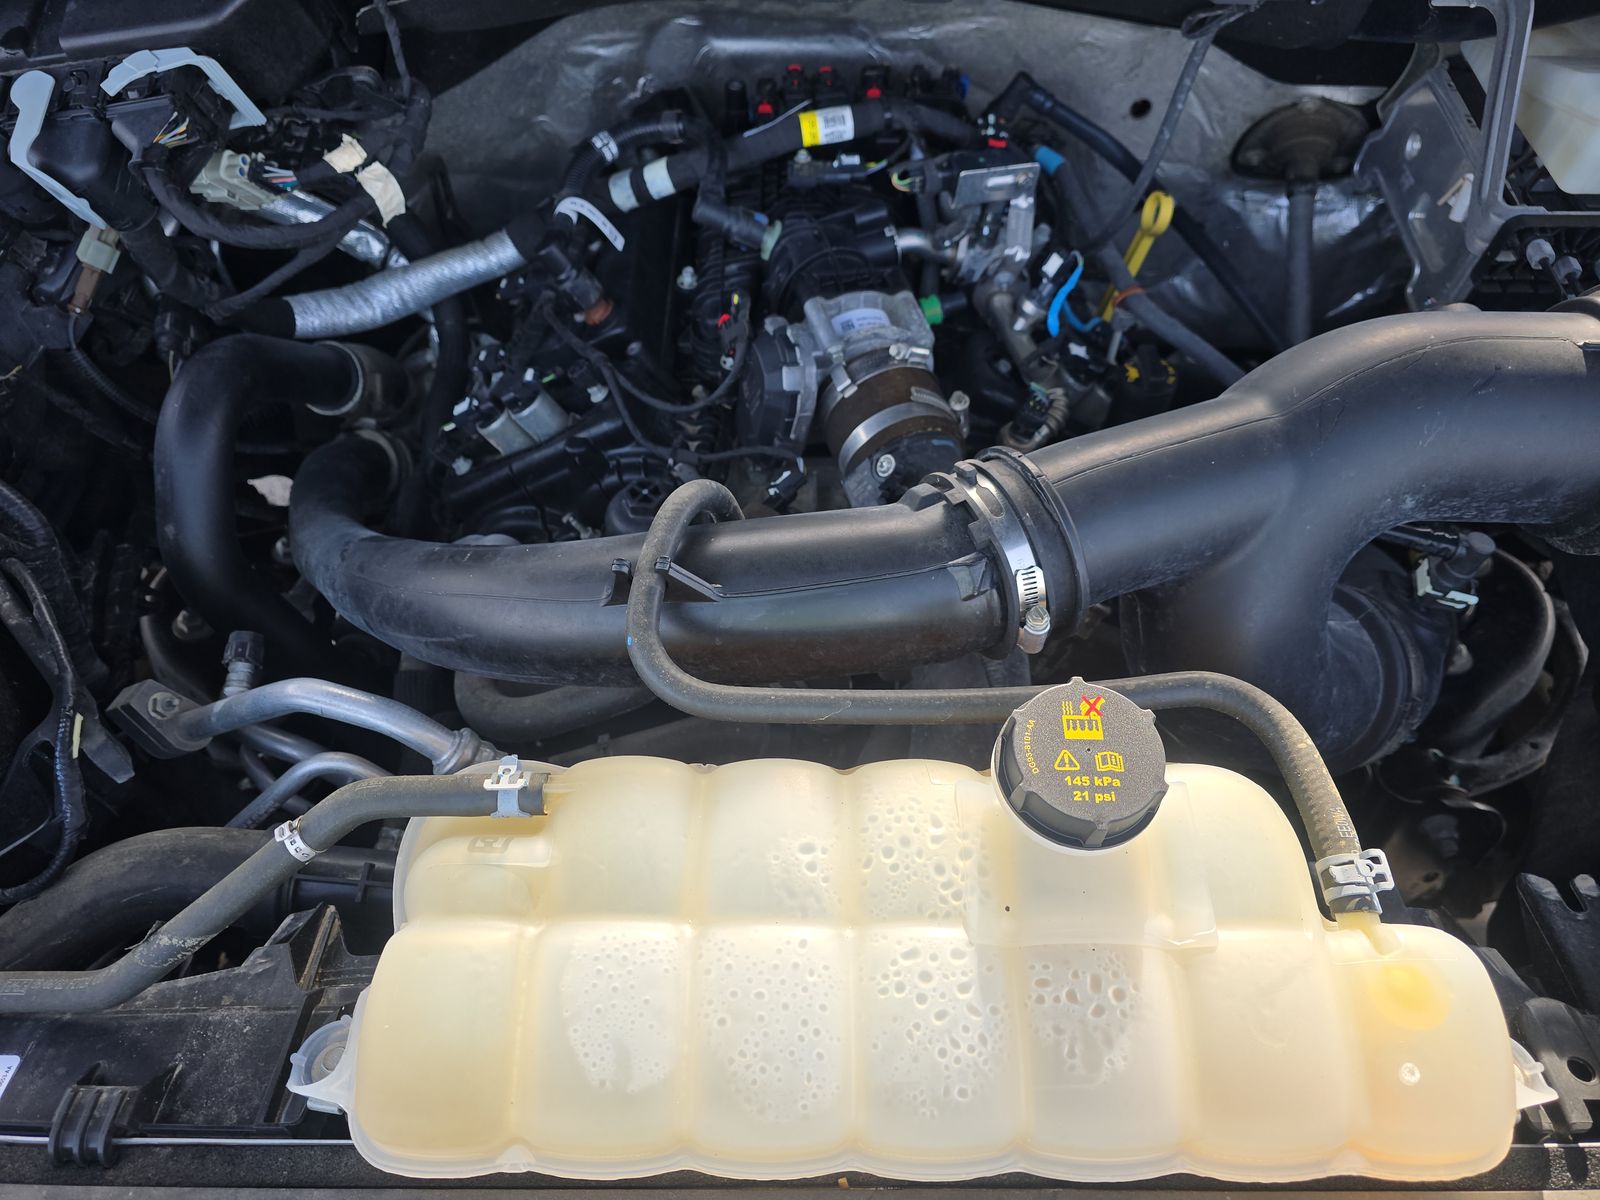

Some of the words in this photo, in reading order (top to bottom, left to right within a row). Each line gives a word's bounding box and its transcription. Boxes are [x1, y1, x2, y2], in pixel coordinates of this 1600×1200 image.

[1064, 776, 1090, 786] 145
[1094, 776, 1120, 787] kPa
[1073, 791, 1089, 801] 21
[1095, 791, 1116, 804] psi
